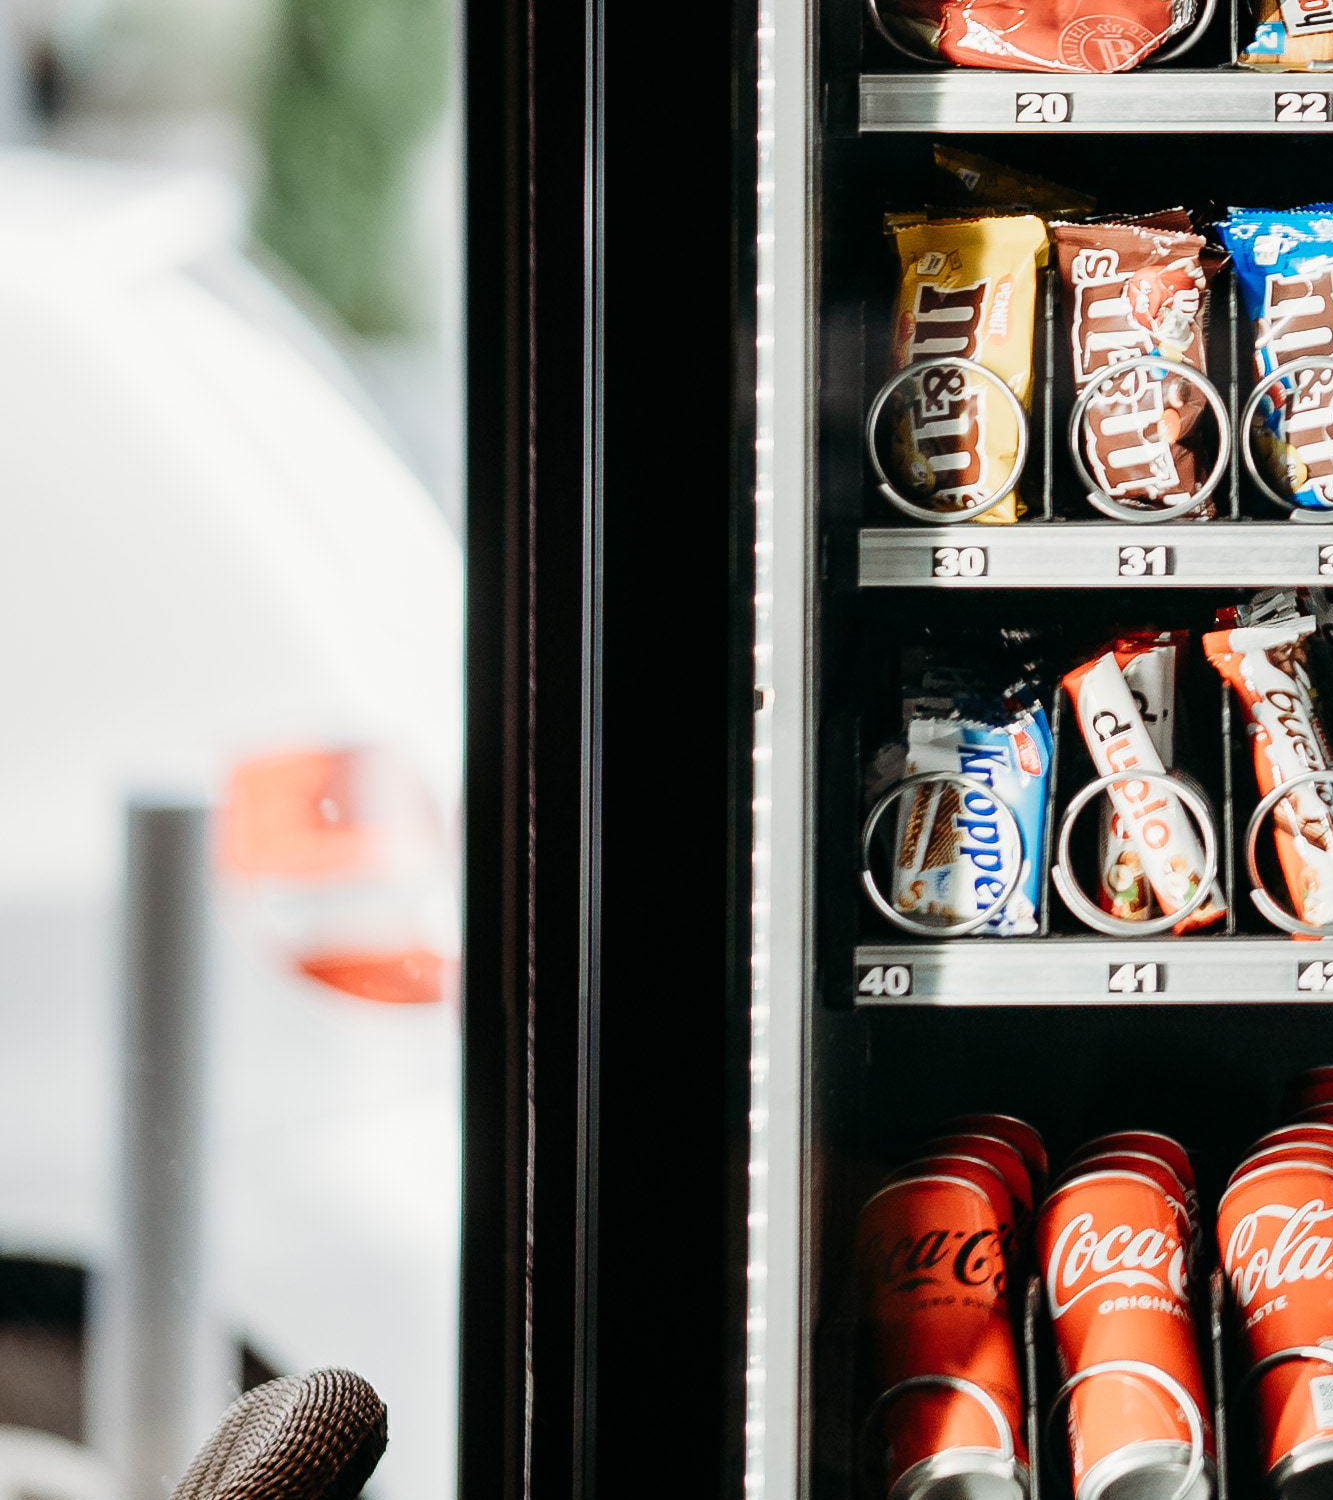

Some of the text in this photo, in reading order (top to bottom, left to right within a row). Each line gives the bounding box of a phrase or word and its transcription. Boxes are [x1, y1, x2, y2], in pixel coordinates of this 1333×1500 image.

[1017, 94, 1069, 122] 20
[1277, 93, 1328, 122] 22
[990, 276, 1012, 338] PEANUT
[934, 548, 986, 577] 30
[1120, 547, 1167, 576] 31
[1092, 710, 1172, 850] duplo
[858, 965, 911, 996] 40
[1108, 963, 1158, 993] 41
